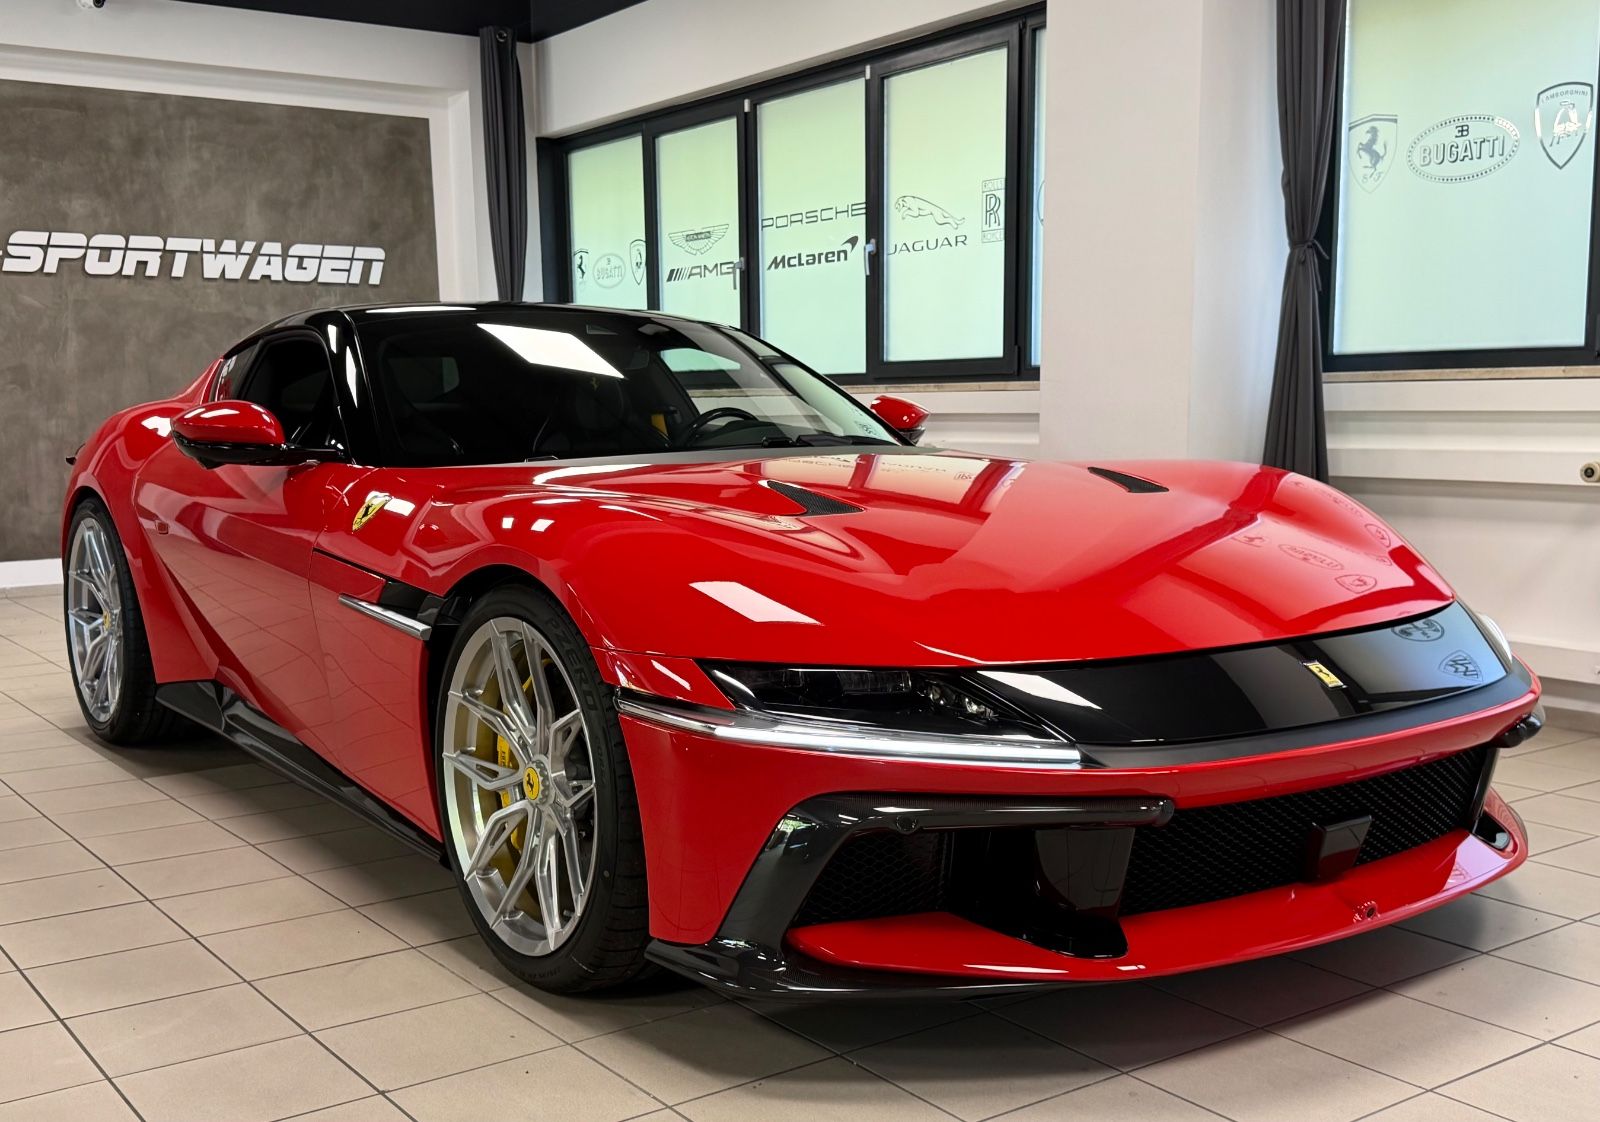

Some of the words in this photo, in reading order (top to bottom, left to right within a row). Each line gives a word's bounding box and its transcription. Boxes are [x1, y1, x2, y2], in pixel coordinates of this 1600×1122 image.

[1541, 89, 1589, 103] LAMBORGHINI
[1419, 135, 1506, 167] BUGATTI
[761, 201, 866, 231] PORSCHE
[2, 231, 386, 285] SPORTWAGEN
[887, 234, 968, 256] JAGUAR
[767, 249, 848, 271] McLaren
